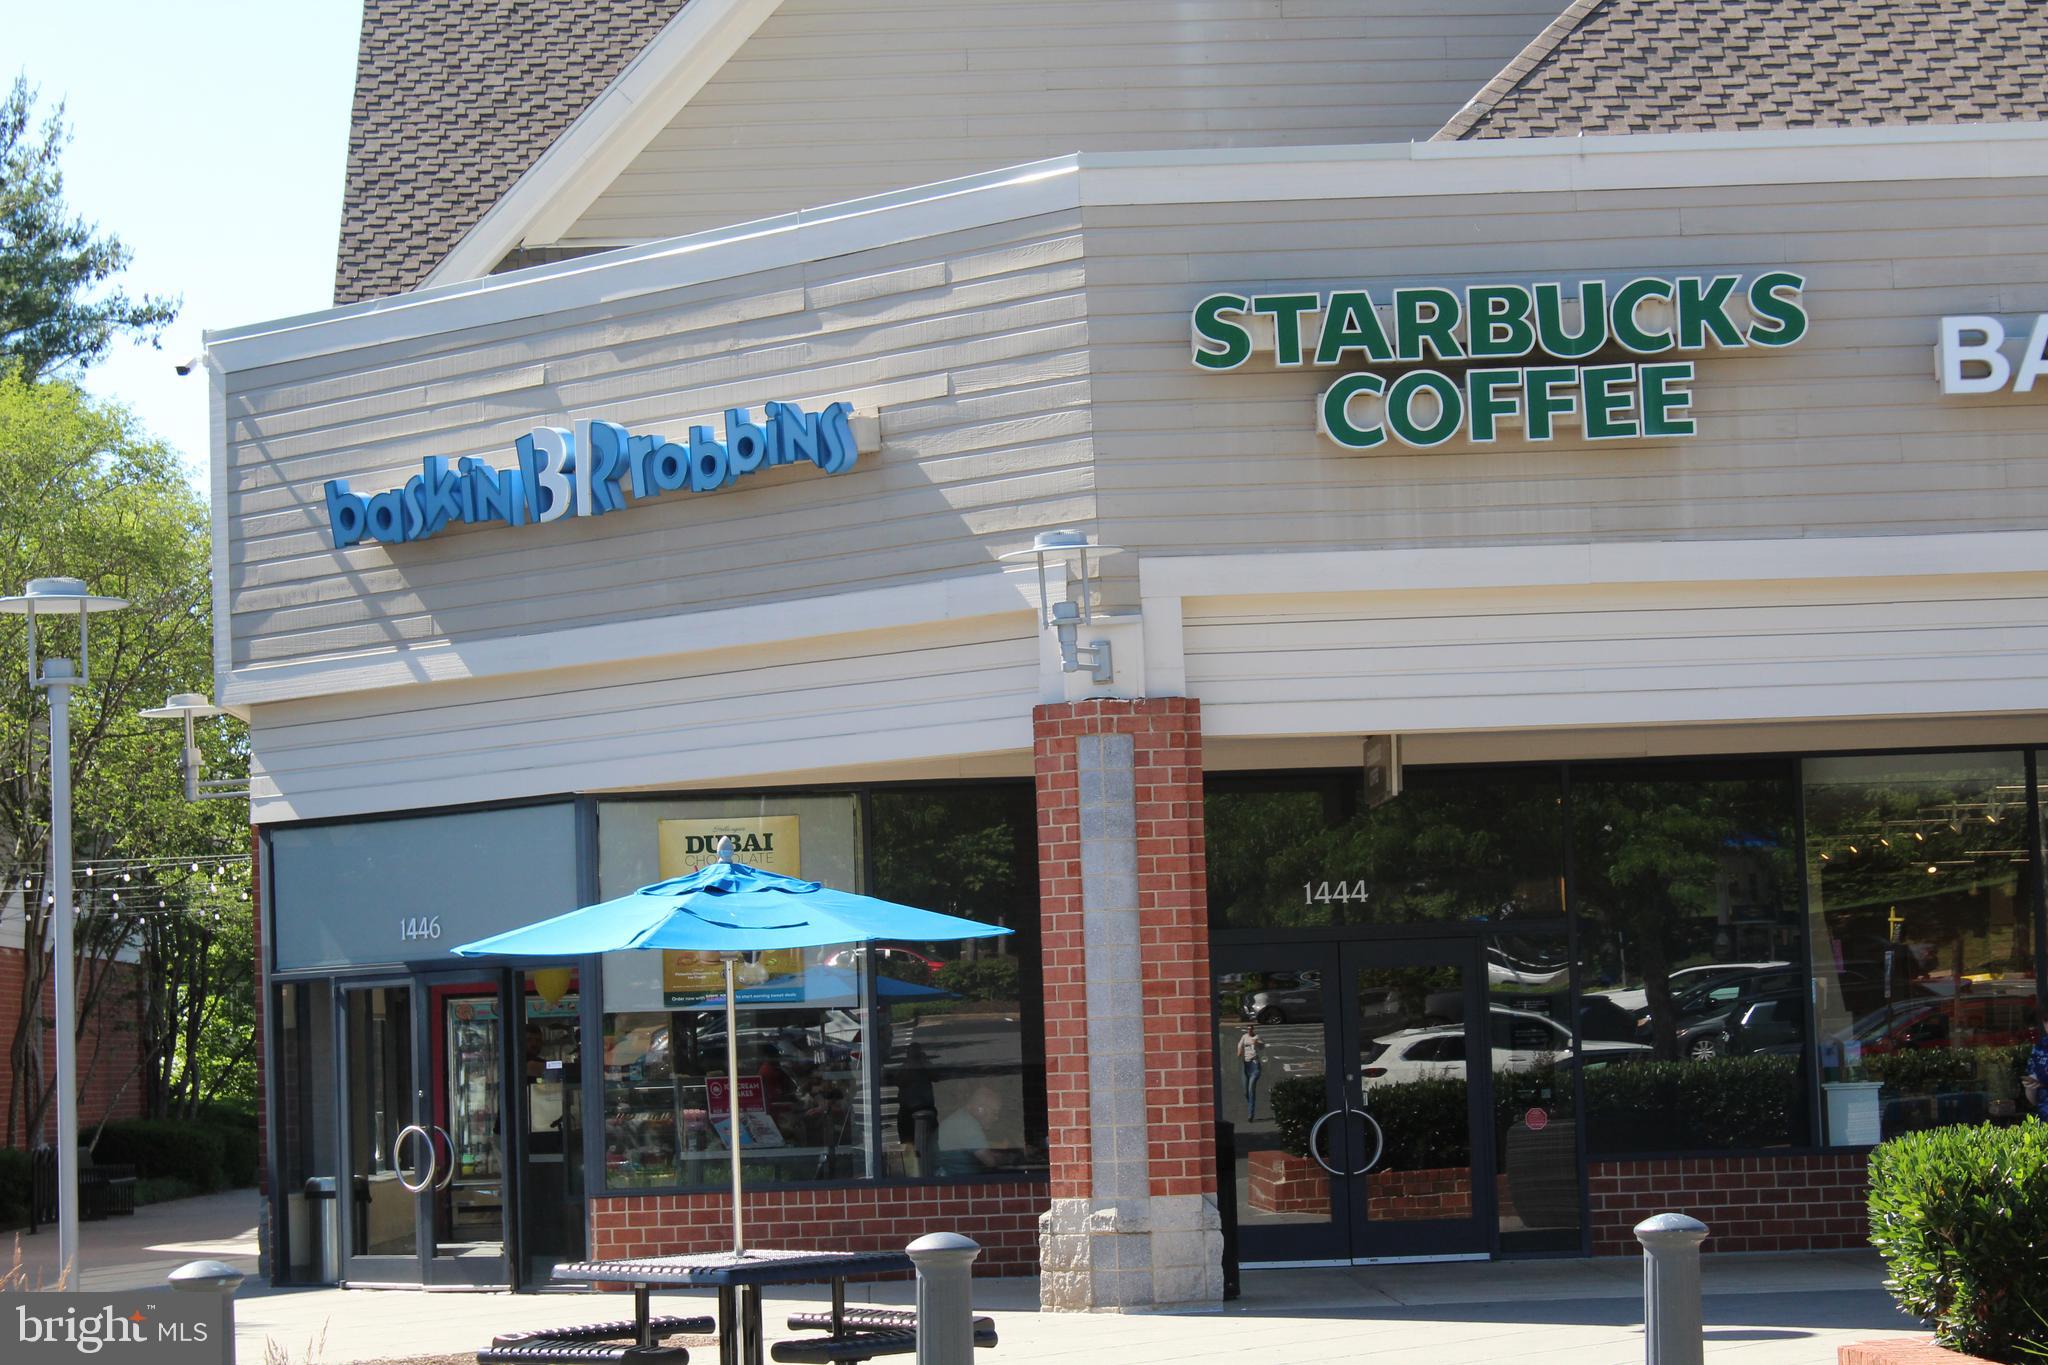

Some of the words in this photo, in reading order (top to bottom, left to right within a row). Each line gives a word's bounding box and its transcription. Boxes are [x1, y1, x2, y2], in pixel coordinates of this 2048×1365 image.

[1191, 271, 1809, 371] STARBUCKS
[1322, 360, 1698, 450] COFFEE
[685, 832, 774, 854] DUBAI
[1303, 879, 1369, 905] 1444
[400, 914, 441, 941] 1446
